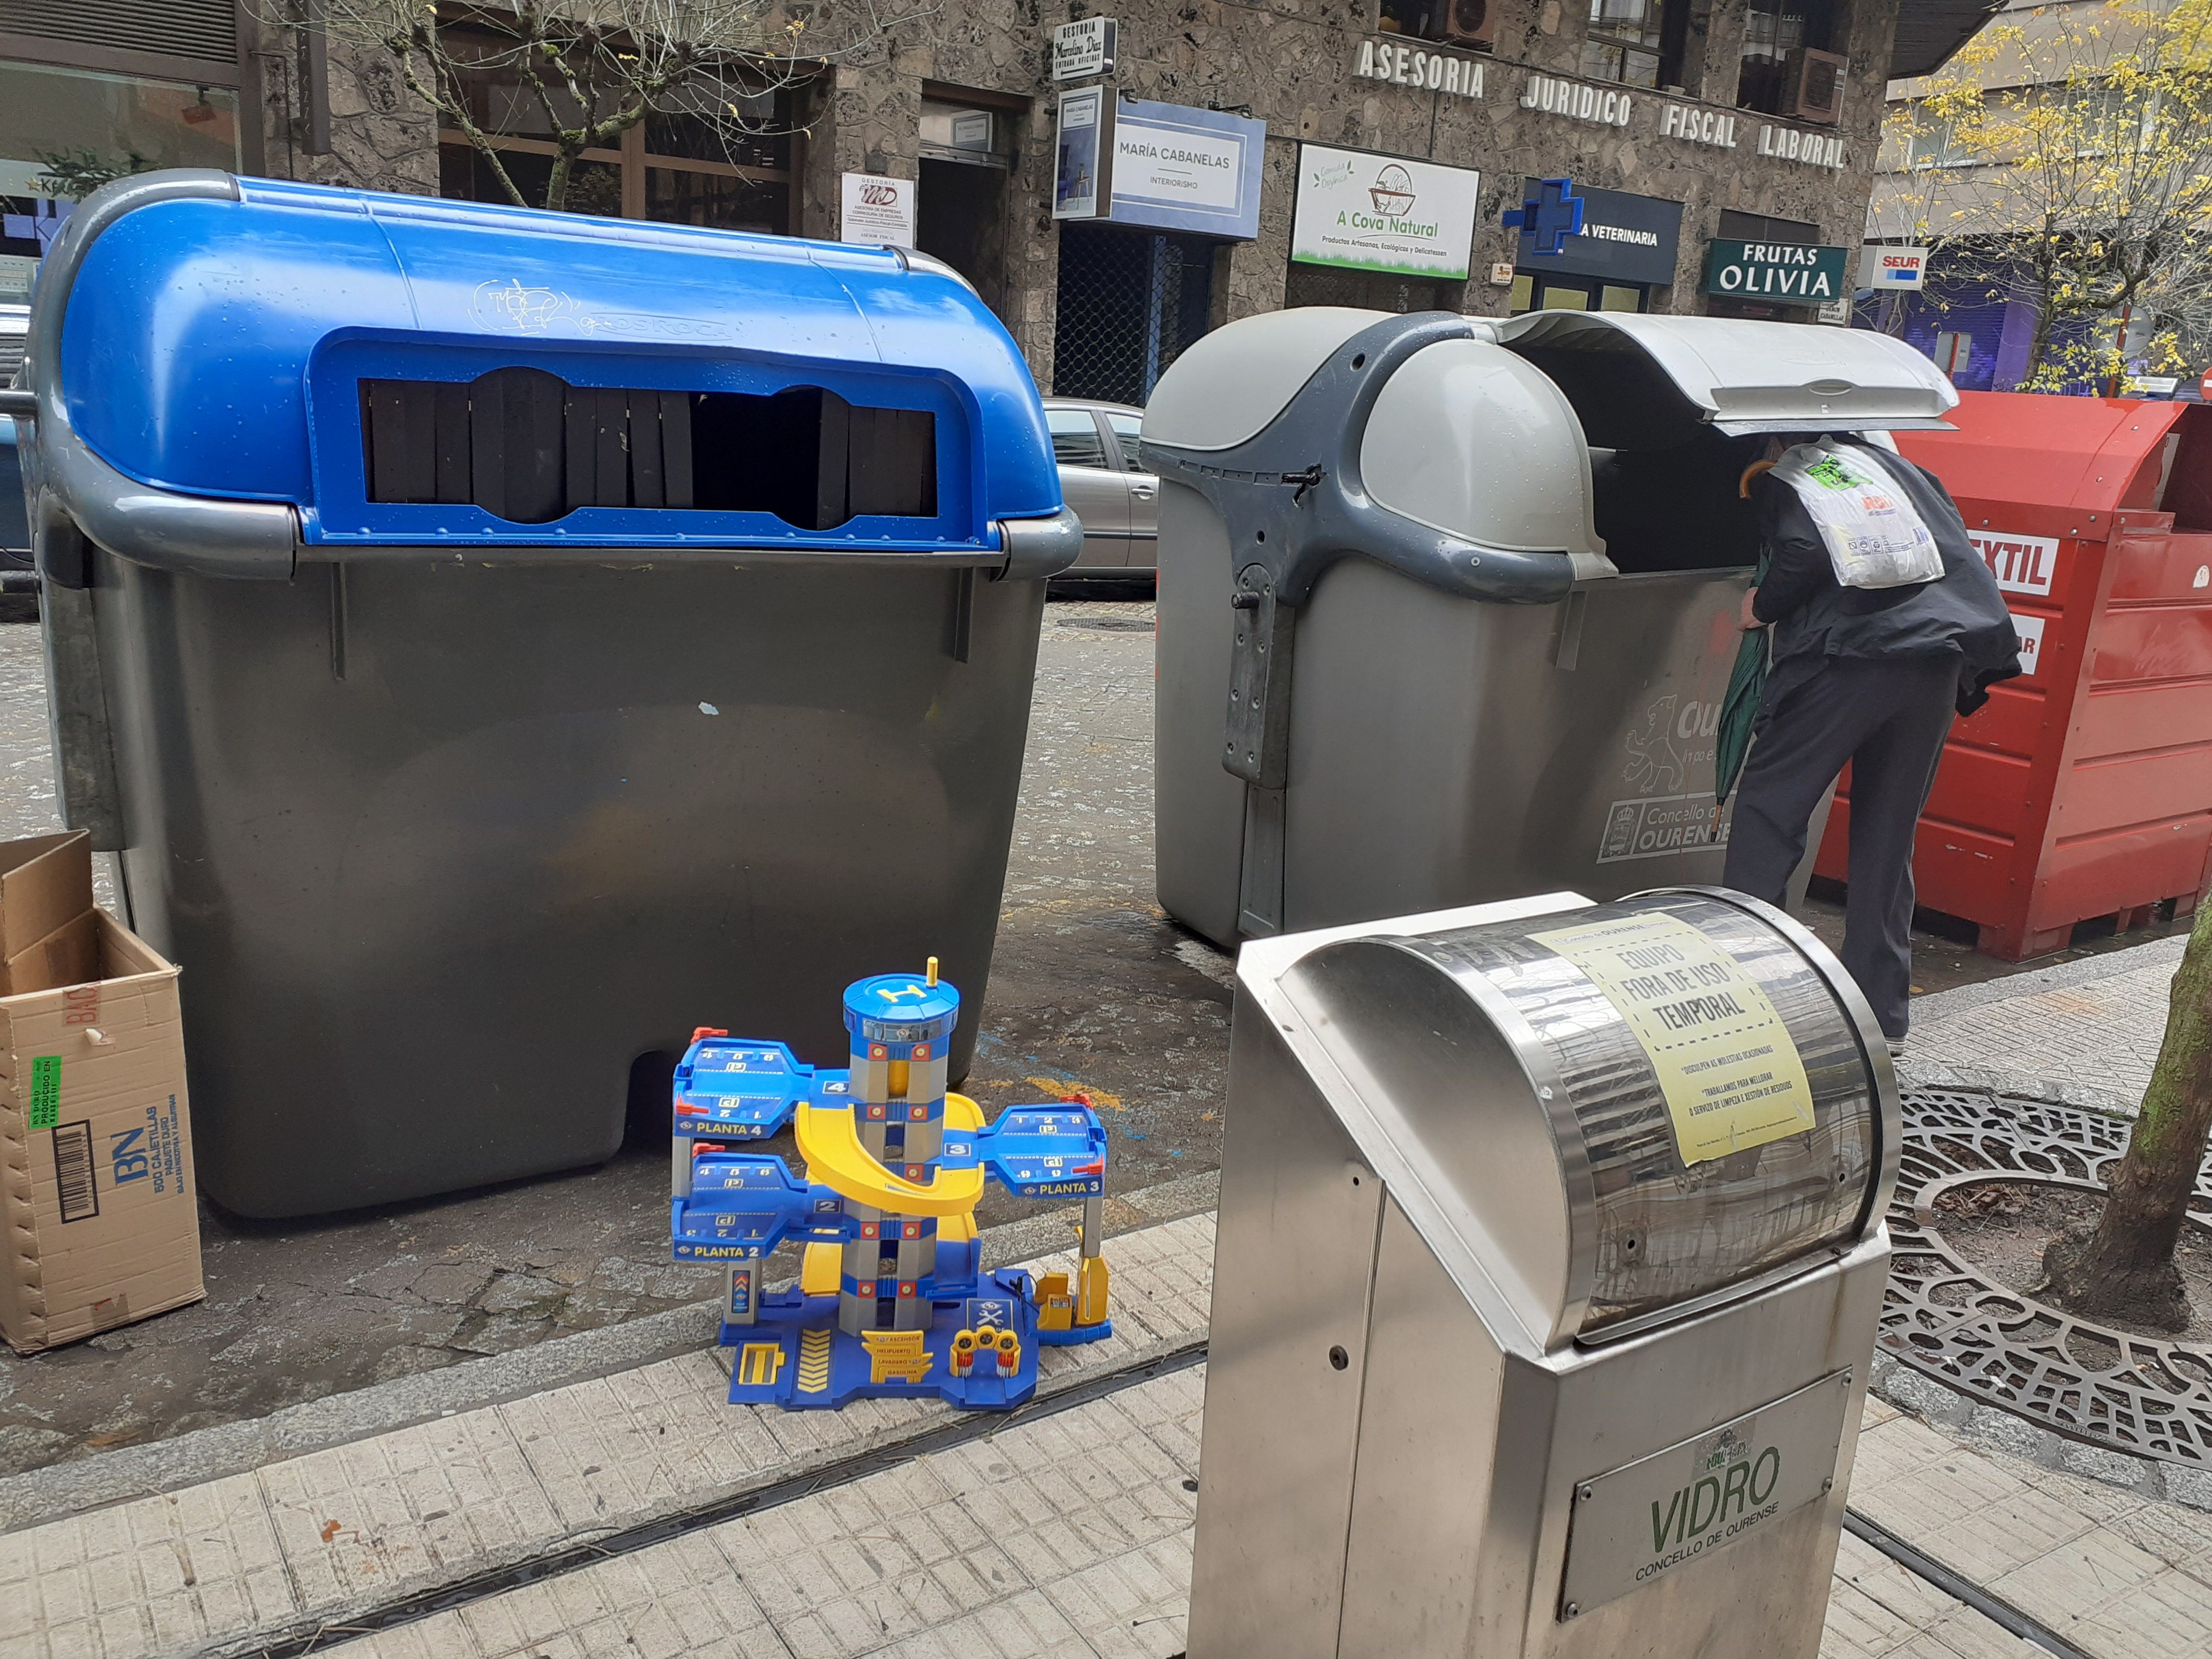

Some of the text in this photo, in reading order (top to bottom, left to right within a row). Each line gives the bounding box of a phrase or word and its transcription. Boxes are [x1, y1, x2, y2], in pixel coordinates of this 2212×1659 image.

[1063, 21, 1095, 39] GESTORIA
[1055, 39, 1083, 59] Marcelino
[1056, 54, 1100, 69] ENTRADA OFICINAS
[1357, 40, 1484, 99] ASESORIA
[1522, 76, 1631, 127] JURIDICO
[1662, 104, 1737, 148] FISCAL
[1120, 141, 1230, 169] MARÍA CABANELAS
[1761, 124, 1844, 169] LABORAL
[862, 178, 895, 186] GESTORÍA
[1150, 176, 1198, 189] INTERIORISMO
[1336, 210, 1438, 237] A Cova Natural
[1322, 235, 1350, 245] Productos
[1381, 243, 1409, 253] Ecológicos
[1415, 246, 1447, 257] Delicatessen
[1592, 225, 1657, 246] VETERINARIA
[1743, 243, 1817, 266] FRUTAS
[1882, 255, 1920, 268] SEUR
[1719, 265, 1830, 297] OLIVIA
[1969, 539, 2047, 586] XTIL
[1647, 804, 1705, 825] Concello
[1601, 924, 1645, 936] OURENSE
[1615, 944, 1685, 971] EQUIPO
[1620, 961, 1731, 1002] FORA DE USO
[1652, 992, 1746, 1032] TEMPORAL
[1710, 1059, 1718, 1068] AS
[1717, 1052, 1742, 1066] MOLESTIAS
[1742, 1045, 1774, 1059] OCASIONADAS
[827, 1082, 846, 1092] 4
[1737, 1078, 1749, 1089] PARA
[1750, 1072, 1773, 1085] MELLORAR
[41, 1061, 50, 1124] PRODUCIDO EN
[1689, 1080, 1792, 1116] O SERVIZO DE LIMPEZA E XESTIÓN DE RESIDUOS
[697, 1123, 762, 1135] PLANTA 4
[110, 1127, 148, 1186] BN
[146, 1106, 165, 1194] 500 CAJETILLAS
[160, 1117, 174, 1176] PAQUETE DURO
[949, 1145, 967, 1155] 3
[175, 1166, 183, 1175] EN
[1040, 1181, 1100, 1194] PLANTA 3
[819, 1201, 836, 1212] 2
[694, 1246, 759, 1257] PLANTA 2
[1651, 1447, 1780, 1553] VIDRO
[1635, 1501, 1780, 1581] CONCELLO DE OURENSE
